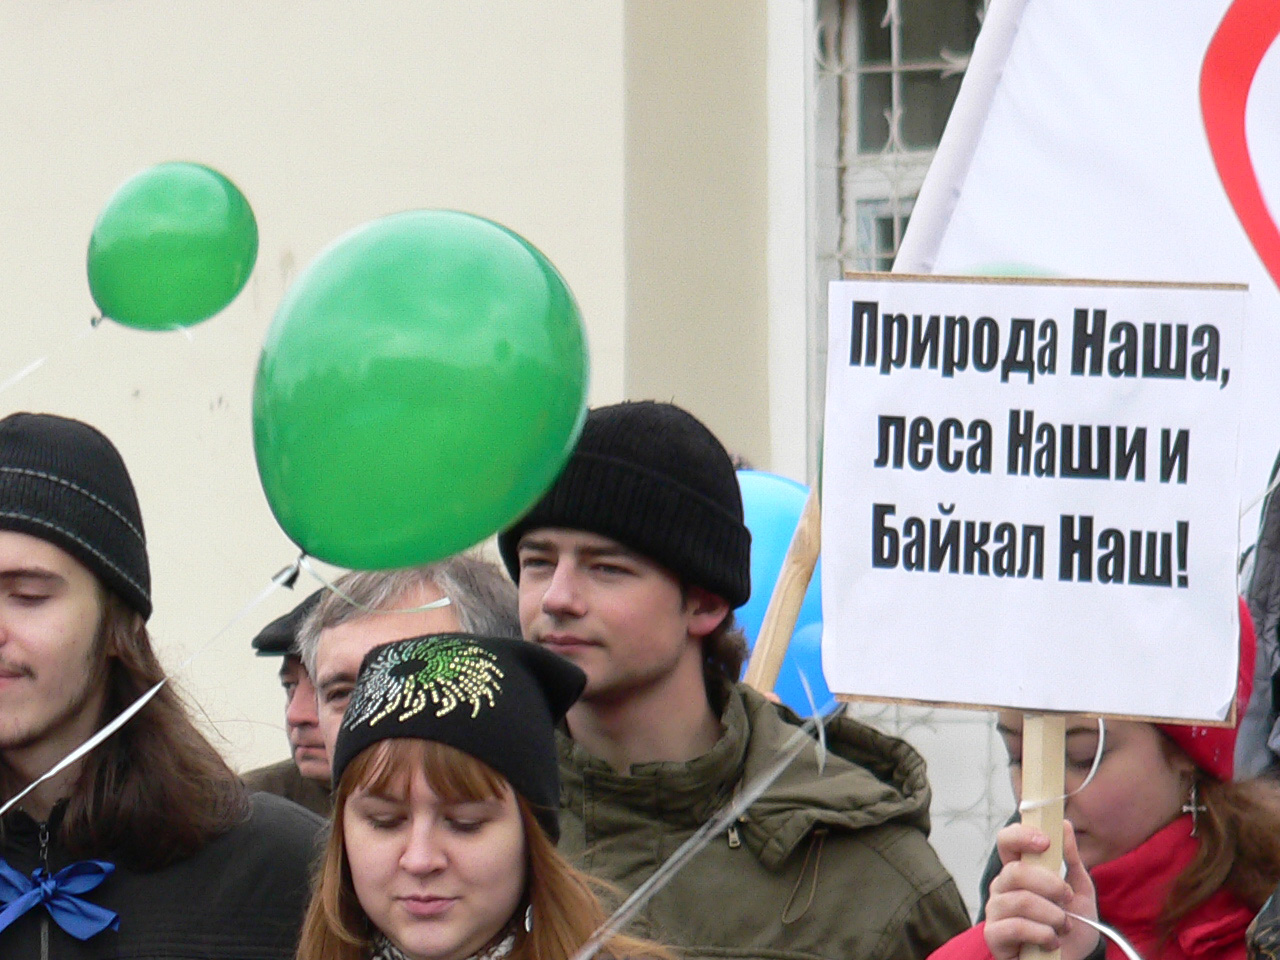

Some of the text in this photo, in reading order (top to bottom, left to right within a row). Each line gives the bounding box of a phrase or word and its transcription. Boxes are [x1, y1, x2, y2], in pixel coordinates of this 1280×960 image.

[849, 300, 1231, 390] Природа Наша,
[873, 409, 1190, 484] леса Наши и
[871, 502, 1190, 588] Байкал Наш!
